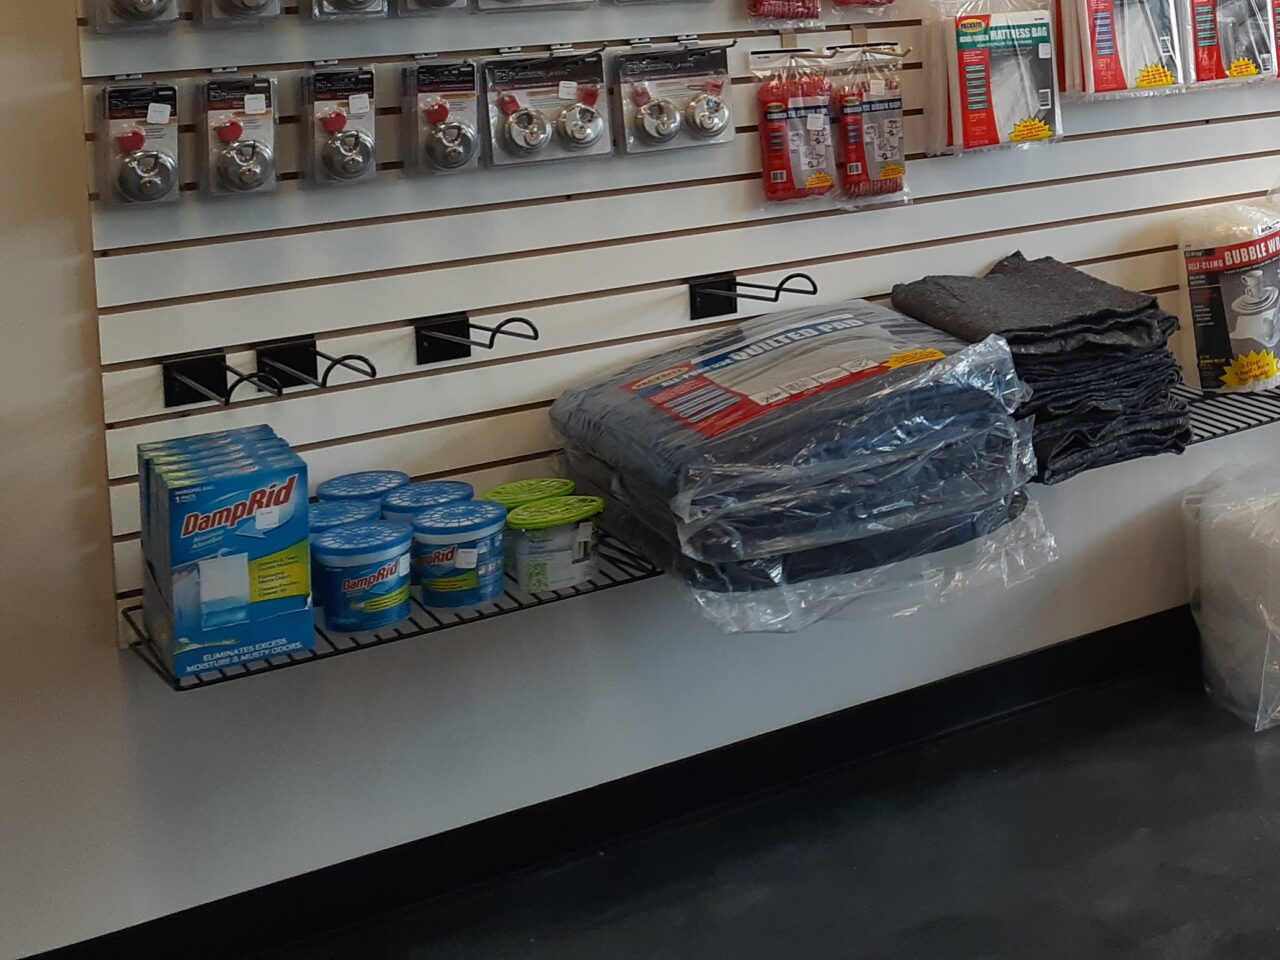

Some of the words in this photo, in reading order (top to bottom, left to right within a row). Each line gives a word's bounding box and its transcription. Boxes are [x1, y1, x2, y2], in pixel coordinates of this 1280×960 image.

[989, 28, 1031, 41] MATTRESS
[1031, 26, 1048, 38] BAG
[1188, 259, 1224, 271] SELF-CLING
[1224, 242, 1267, 266] BUBBLE
[730, 326, 811, 361] QUILTED
[818, 318, 865, 334] PAD
[181, 473, 299, 538] DampRid
[342, 558, 399, 593] DampRid
[186, 657, 232, 672] MOISTURE
[240, 647, 271, 660] MUSTY
[203, 644, 255, 661] ELIMINATES
[255, 637, 288, 651] EXCESS
